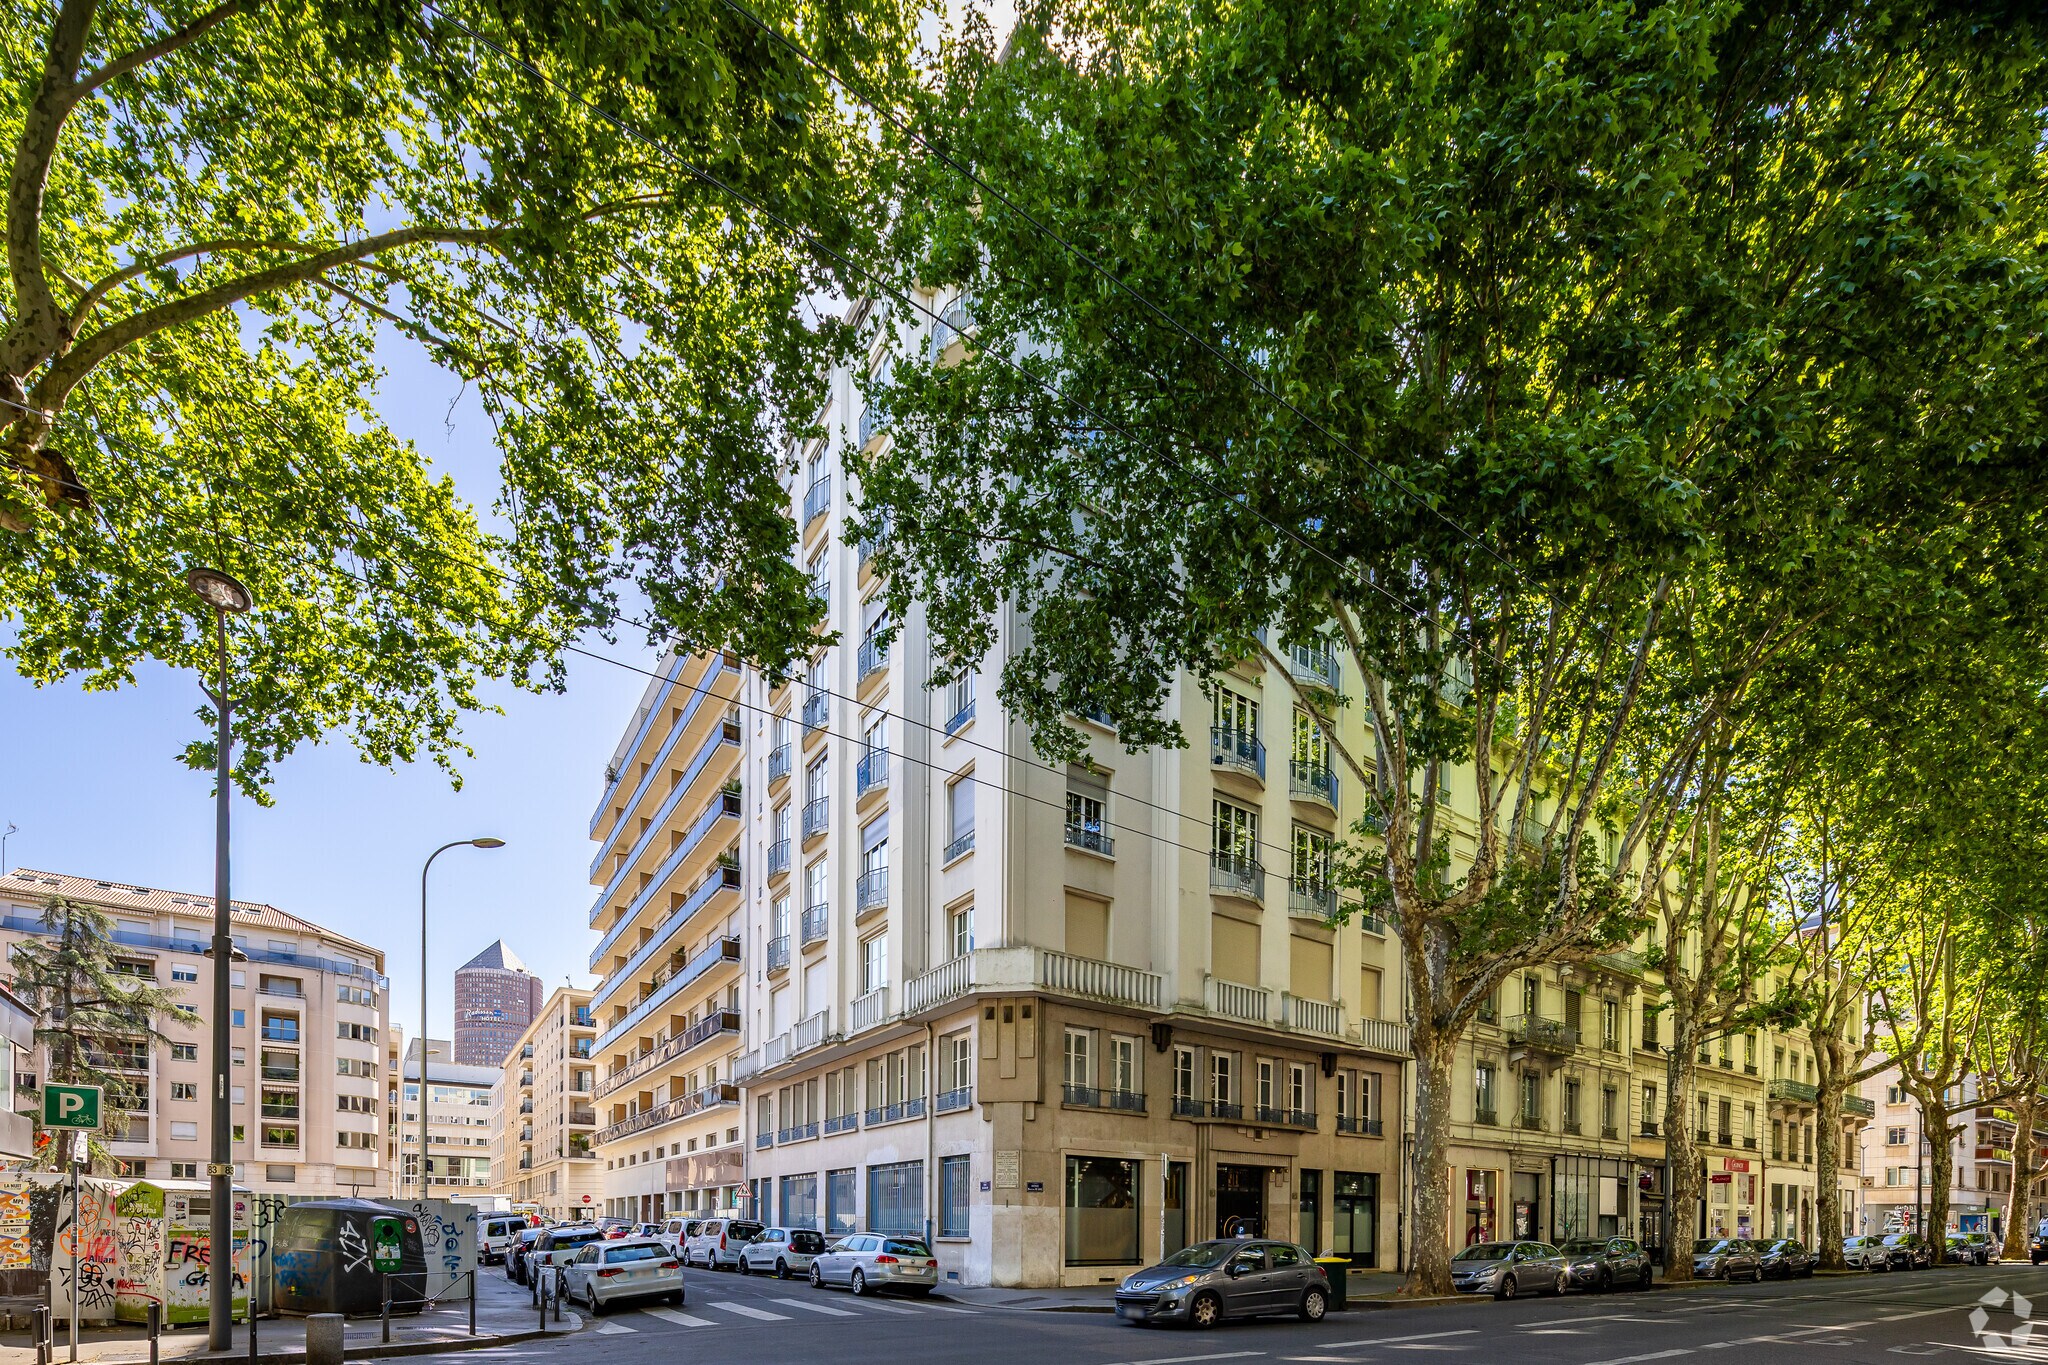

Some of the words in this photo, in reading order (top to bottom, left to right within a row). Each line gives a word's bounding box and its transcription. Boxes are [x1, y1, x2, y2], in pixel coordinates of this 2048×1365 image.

[464, 1008, 494, 1020] Radisson
[60, 1092, 84, 1119] P
[208, 1165, 217, 1174] 83
[225, 1166, 234, 1175] 83
[1239, 1226, 1244, 1234] P
